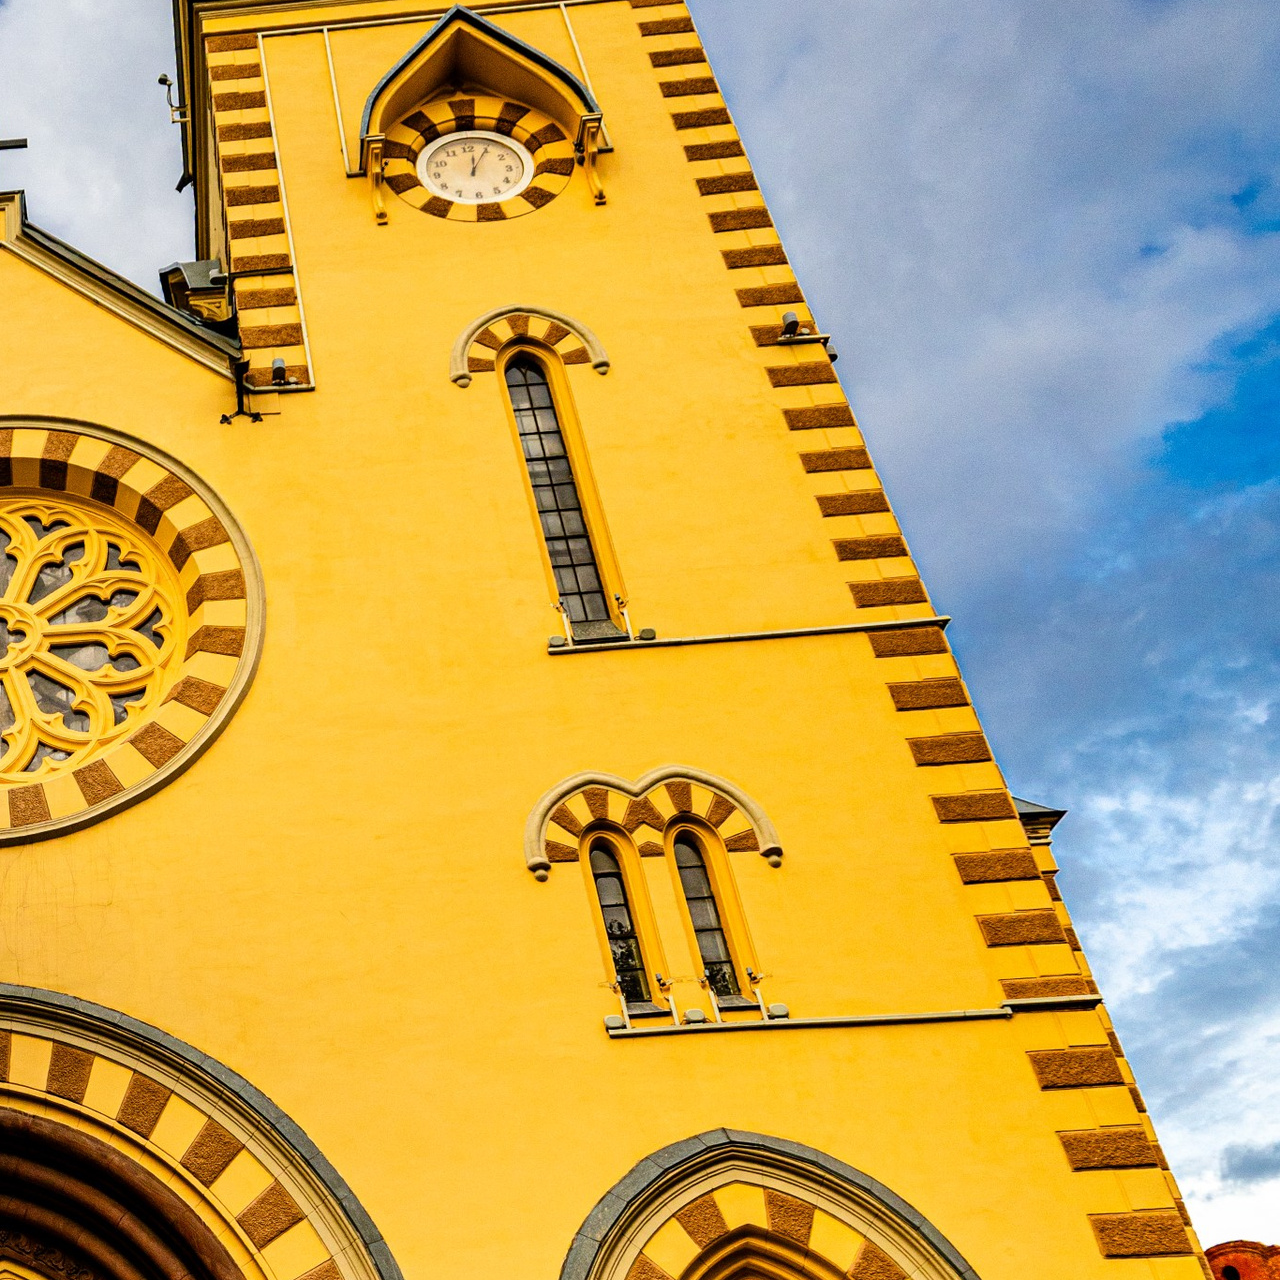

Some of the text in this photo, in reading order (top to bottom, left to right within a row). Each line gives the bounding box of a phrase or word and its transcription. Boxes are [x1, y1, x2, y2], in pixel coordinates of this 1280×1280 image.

[461, 145, 475, 153] 12
[497, 153, 506, 161] 2
[434, 160, 448, 168] 10
[505, 164, 513, 172] 3
[503, 176, 511, 184] 4
[455, 189, 463, 198] 7
[493, 186, 501, 195] 5
[475, 191, 483, 199] 6
